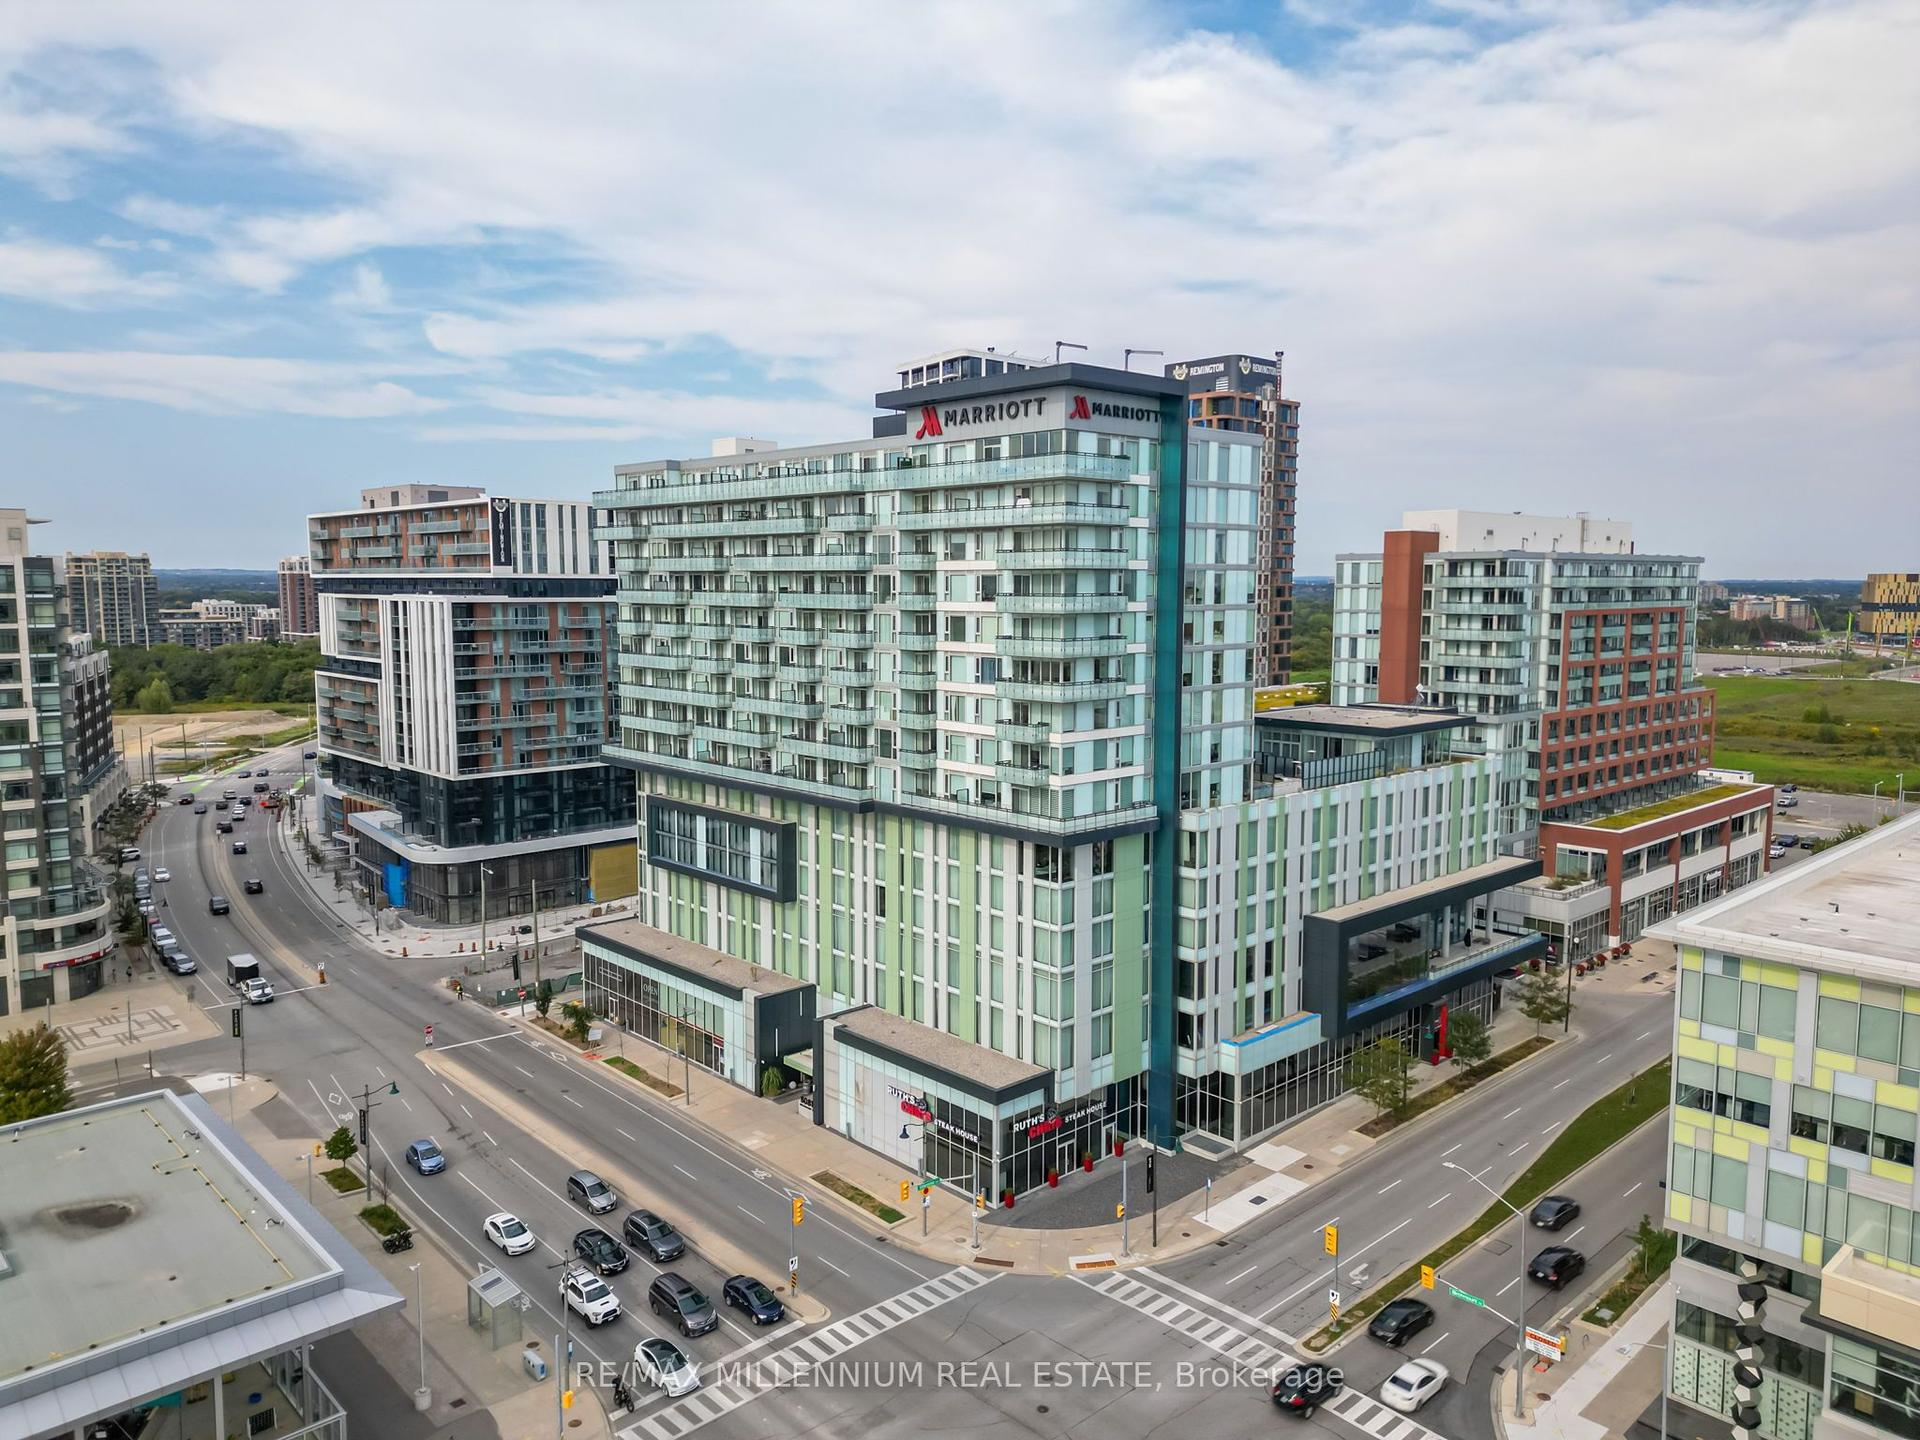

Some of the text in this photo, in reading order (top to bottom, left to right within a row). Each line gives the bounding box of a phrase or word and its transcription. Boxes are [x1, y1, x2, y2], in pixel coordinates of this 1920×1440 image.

[1189, 363, 1225, 376] REMINGTON
[943, 397, 1047, 427] MARRIOTT
[1092, 402, 1162, 423] MARRIOTT
[643, 983, 658, 996] OPEN
[887, 1085, 916, 1104] RUTH'S
[1064, 1100, 1107, 1124] STEAK HOUSE
[934, 1118, 979, 1144] STEAK HOUSE
[1013, 1113, 1045, 1133] RUTH'S
